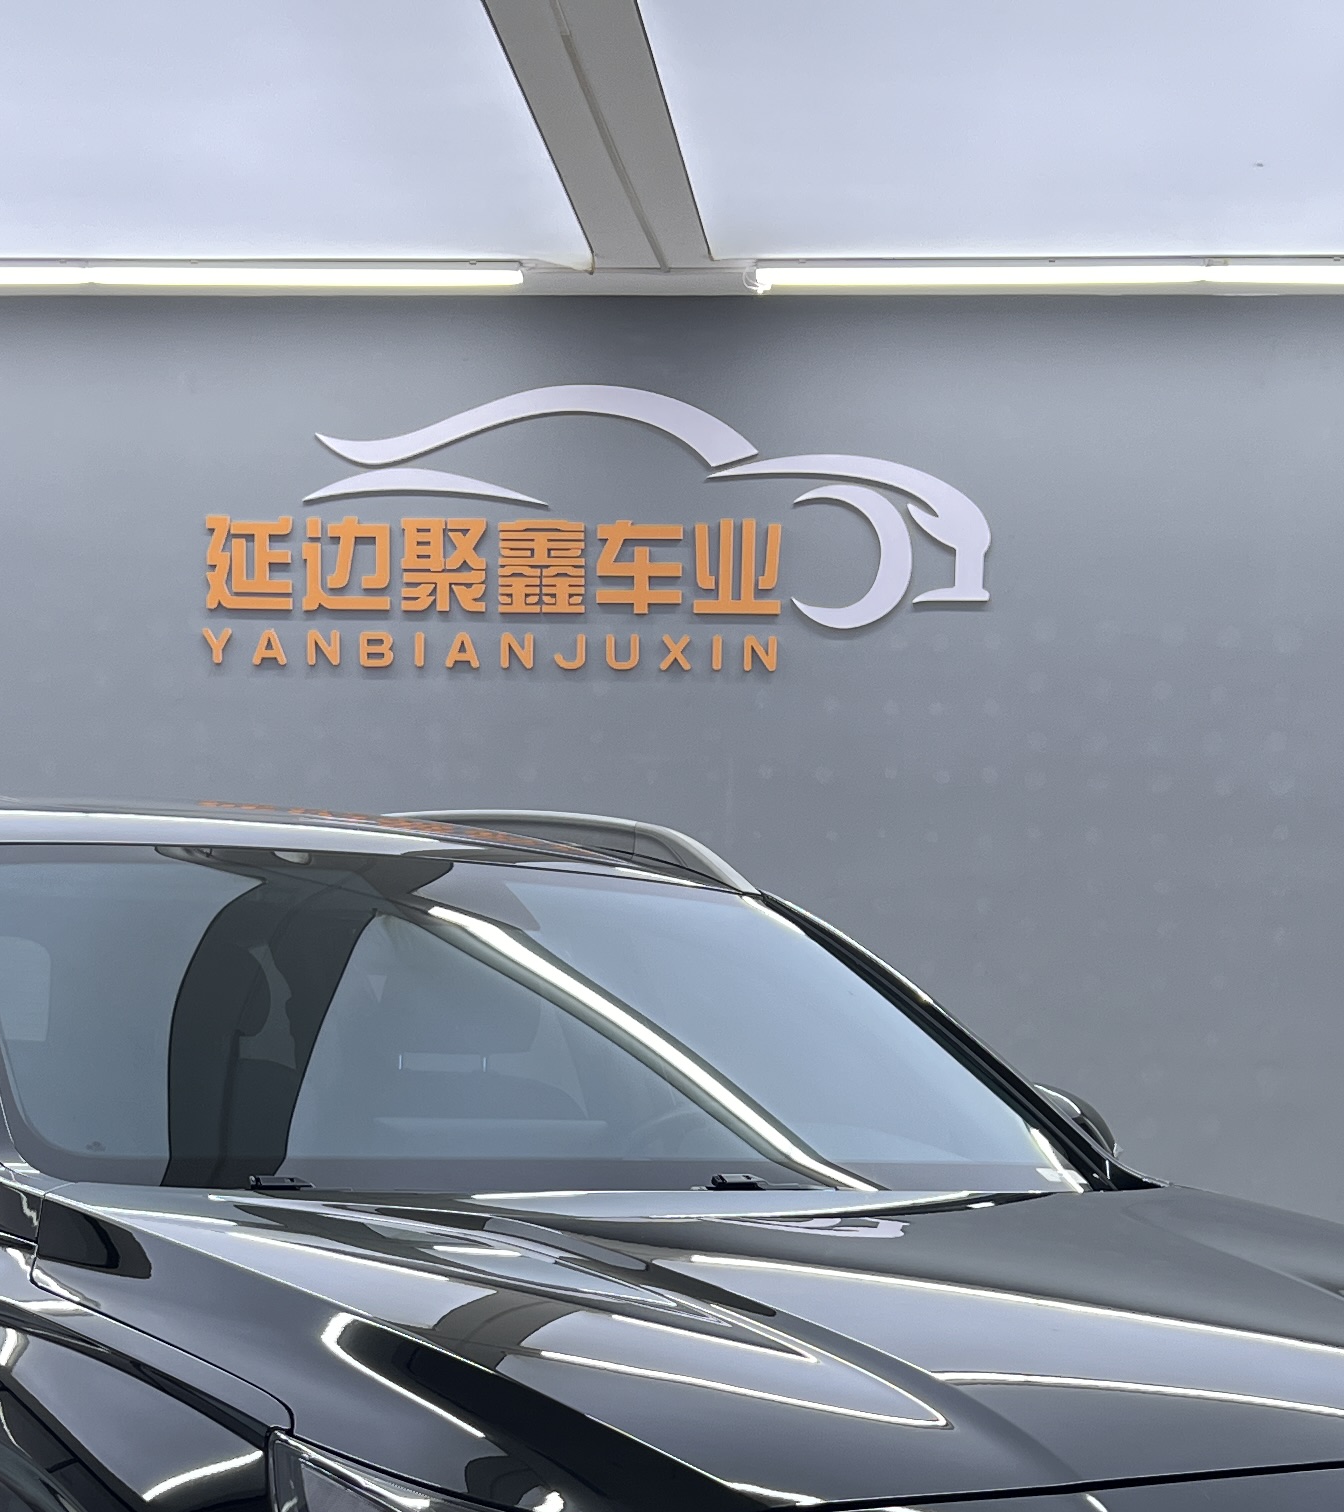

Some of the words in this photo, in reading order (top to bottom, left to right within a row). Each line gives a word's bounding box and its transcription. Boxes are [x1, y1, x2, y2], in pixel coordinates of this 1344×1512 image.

[205, 515, 782, 616] 延边聚鑫车业
[202, 628, 779, 672] YANBIANJUXIN
